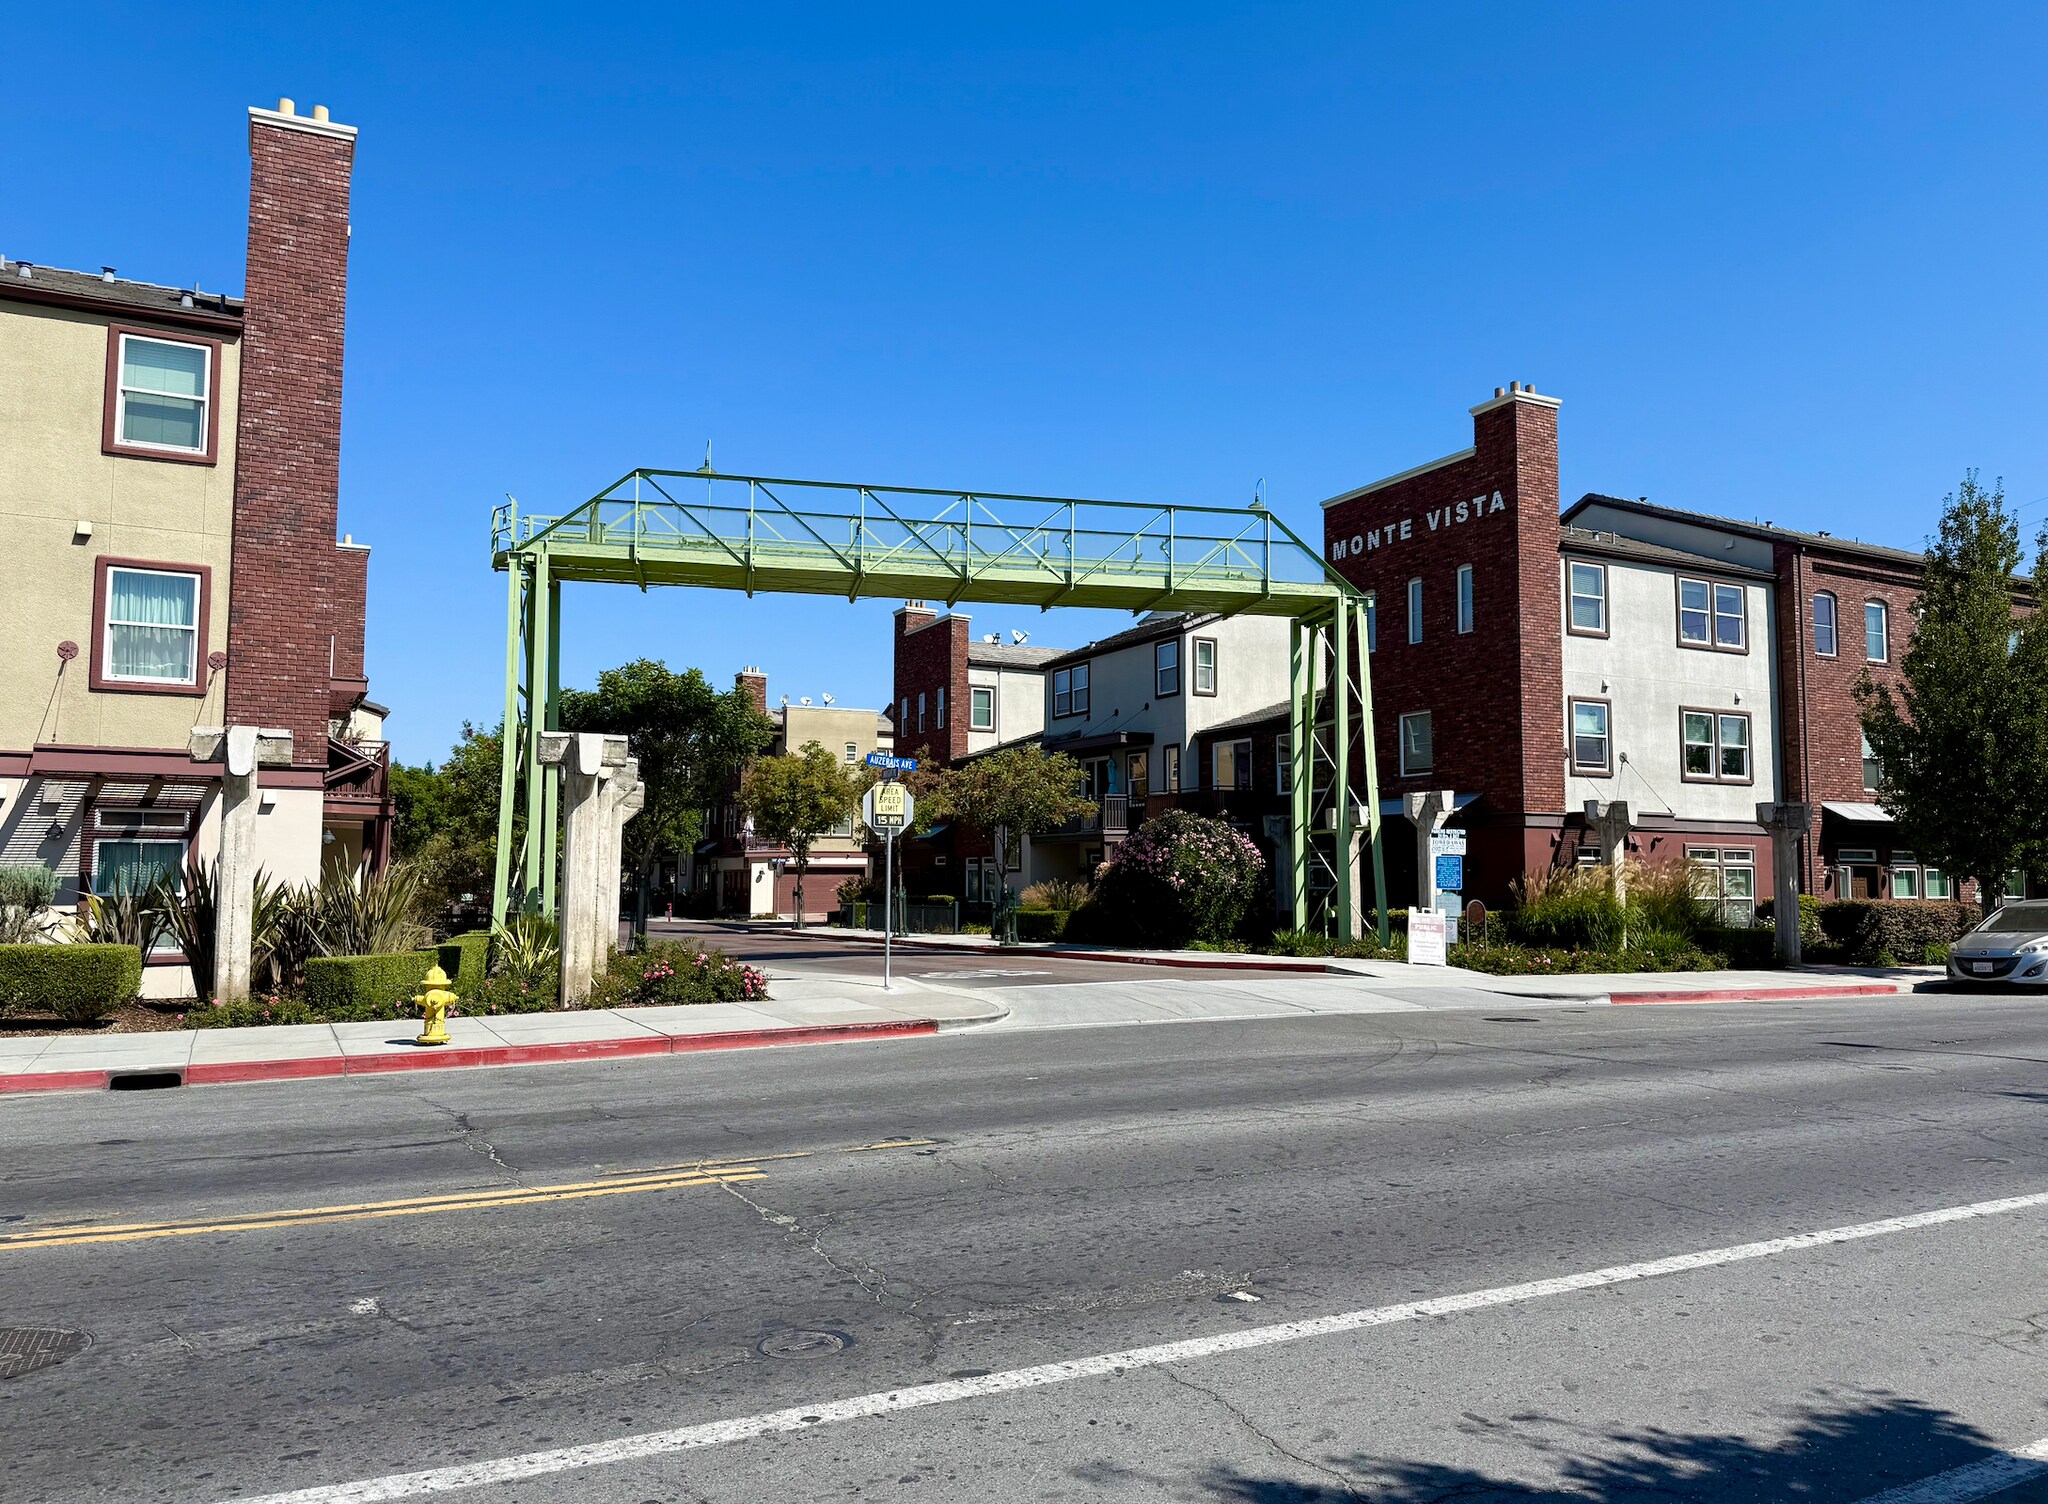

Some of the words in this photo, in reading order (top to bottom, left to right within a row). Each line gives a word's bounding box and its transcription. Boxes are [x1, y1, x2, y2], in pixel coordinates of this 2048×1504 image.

[1332, 518, 1413, 561] MONTE
[1426, 490, 1506, 532] VISTA
[869, 756, 900, 768] AUZERAIS
[900, 760, 913, 770] AVE
[882, 787, 899, 795] AREA
[879, 796, 902, 804] SPEED
[881, 804, 899, 812] LIMIT
[877, 815, 888, 824] 15
[889, 816, 903, 825] MPH
